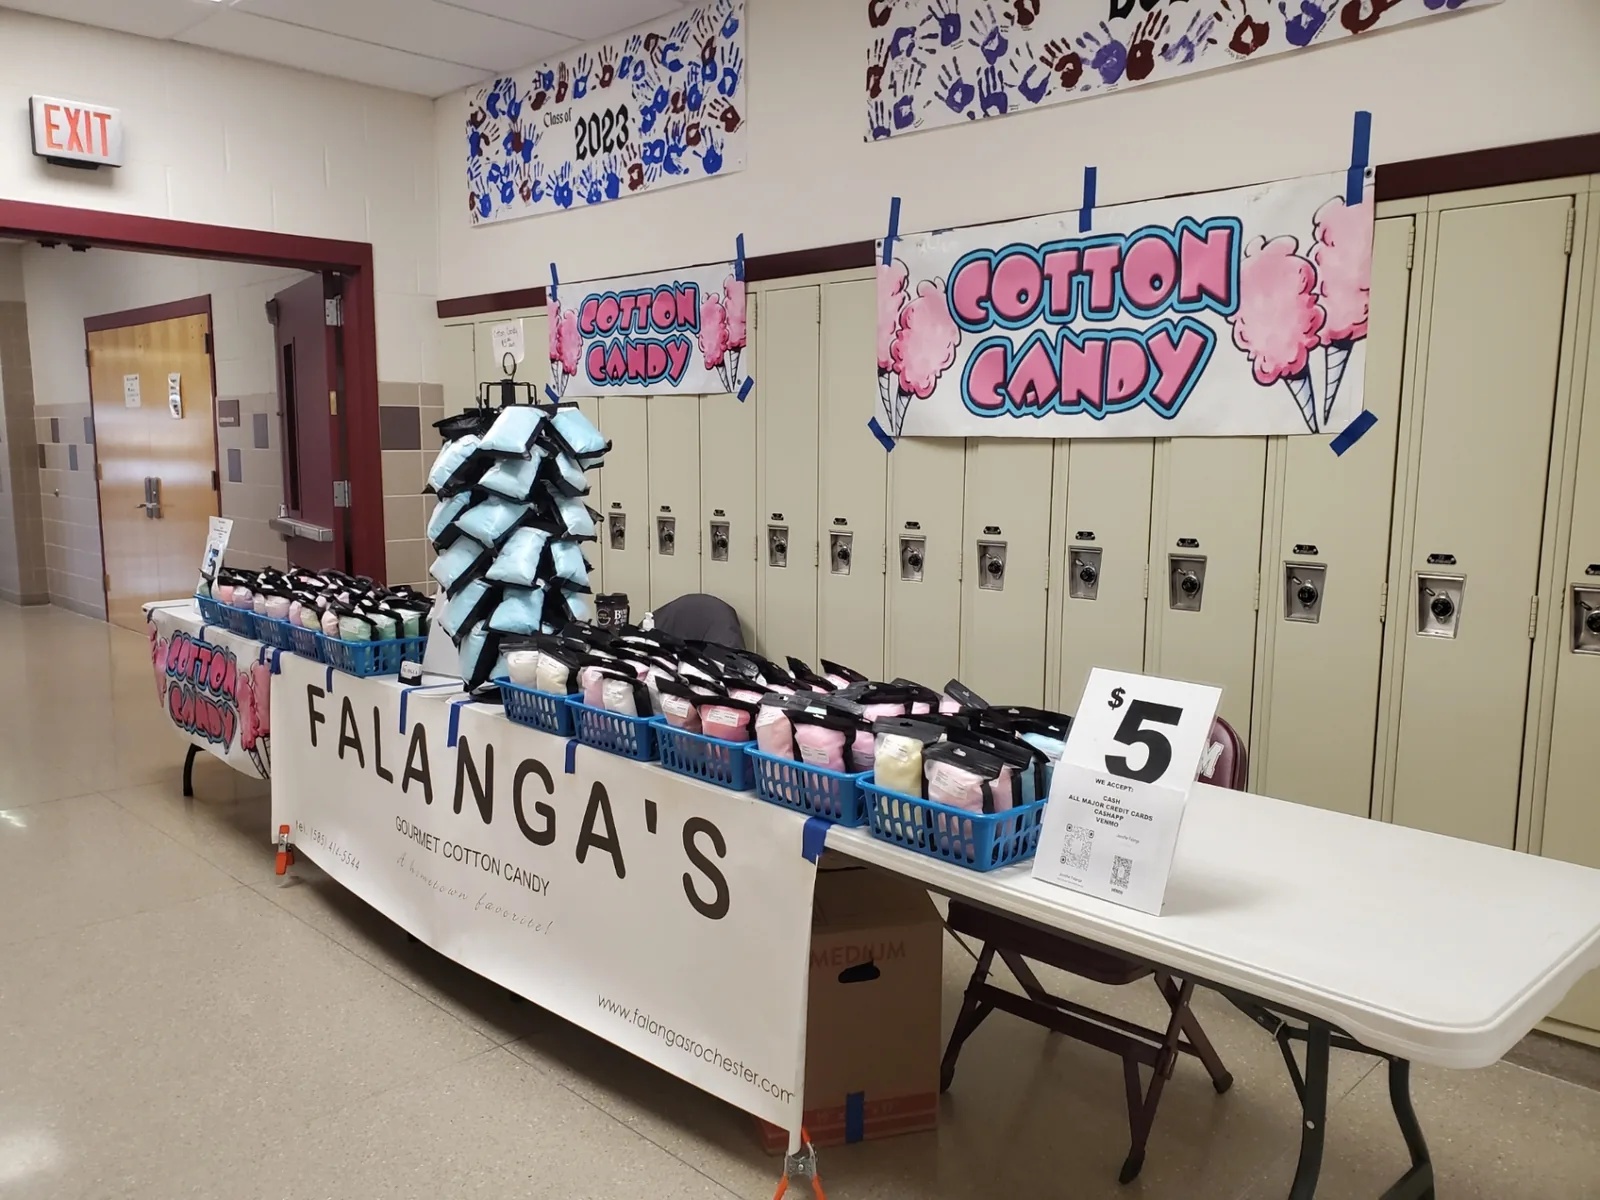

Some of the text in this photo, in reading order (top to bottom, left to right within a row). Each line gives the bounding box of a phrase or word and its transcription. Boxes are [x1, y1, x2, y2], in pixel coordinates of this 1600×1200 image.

[44, 103, 111, 157] EXIT
[543, 107, 572, 128] Class of
[574, 104, 629, 162] 2023
[948, 216, 1243, 333] COTTON
[577, 280, 701, 339] COTTON
[585, 333, 693, 387] CANDY
[960, 316, 1217, 420] CANDY
[166, 630, 238, 708] COTTON
[169, 681, 238, 755] CANDY
[307, 684, 731, 920] FALANGA'S
[1068, 794, 1153, 822] ALL MAJOR CREDIT CARDS
[1095, 778, 1134, 792] WE ACCEPT:
[1103, 795, 1121, 805] CASH
[1094, 808, 1125, 821] CASHAPP
[1095, 817, 1119, 828] VENMO
[395, 816, 550, 897] GOURMET COTTON CANDY
[409, 858, 469, 901] hometown
[474, 892, 554, 935] favorite!
[810, 940, 906, 968] MEDIUM
[597, 994, 796, 1104] www.falangasrochester.com
